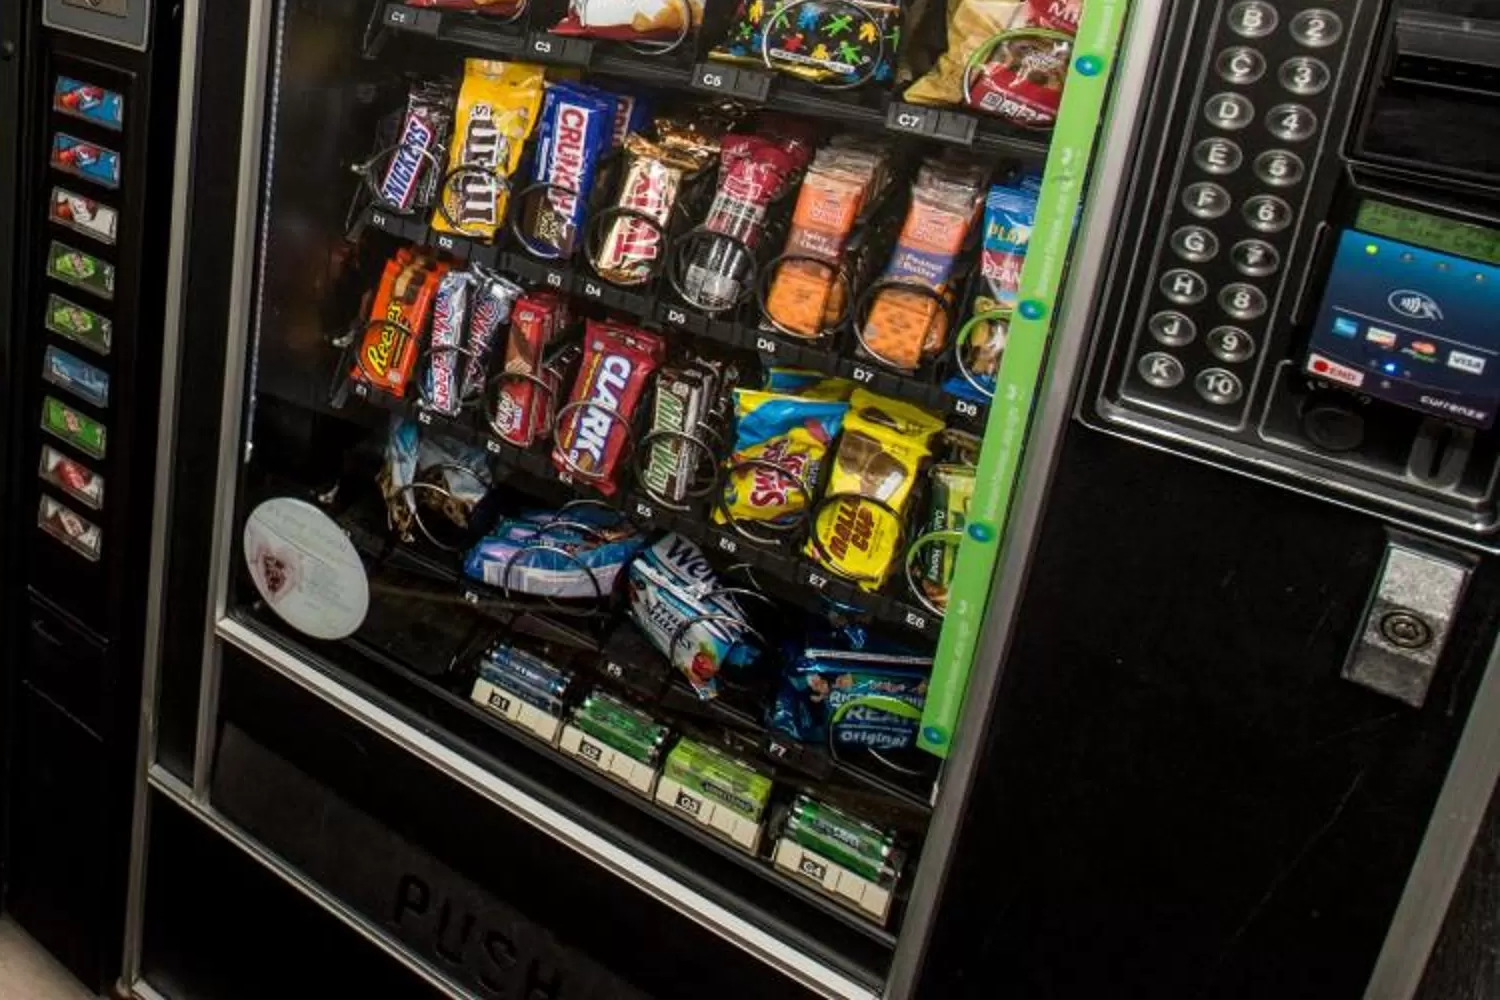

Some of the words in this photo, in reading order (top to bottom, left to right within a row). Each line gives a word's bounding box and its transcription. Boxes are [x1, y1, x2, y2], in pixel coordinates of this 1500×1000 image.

[1242, 9, 1263, 28] B
[1306, 19, 1325, 37] 2
[535, 41, 551, 53] C3
[1231, 54, 1251, 74] C
[703, 74, 721, 87] C5
[1294, 66, 1312, 84] 3
[1219, 101, 1239, 119] D
[898, 113, 920, 127] C7
[1283, 113, 1299, 130] 4
[383, 121, 429, 203] SNICKERS
[550, 109, 585, 217] CRUNCH
[1208, 146, 1228, 164] E
[1270, 159, 1287, 176] 5
[1198, 190, 1215, 206] F
[1258, 203, 1275, 221] 6
[439, 237, 453, 248] D2
[1185, 232, 1204, 250] G
[585, 283, 601, 297] D4
[1173, 276, 1193, 295] H
[1234, 291, 1250, 308] 8
[668, 310, 686, 324] D5
[1164, 318, 1179, 335] J
[1222, 334, 1238, 351] 9
[853, 367, 873, 382] D7
[1151, 359, 1171, 378] K
[1206, 375, 1233, 395] 10
[576, 355, 632, 459] CLARK
[851, 505, 876, 552] CUP
[809, 574, 827, 588] E7
[840, 729, 909, 748] Original
[770, 742, 788, 756] F7
[803, 861, 821, 876] G4
